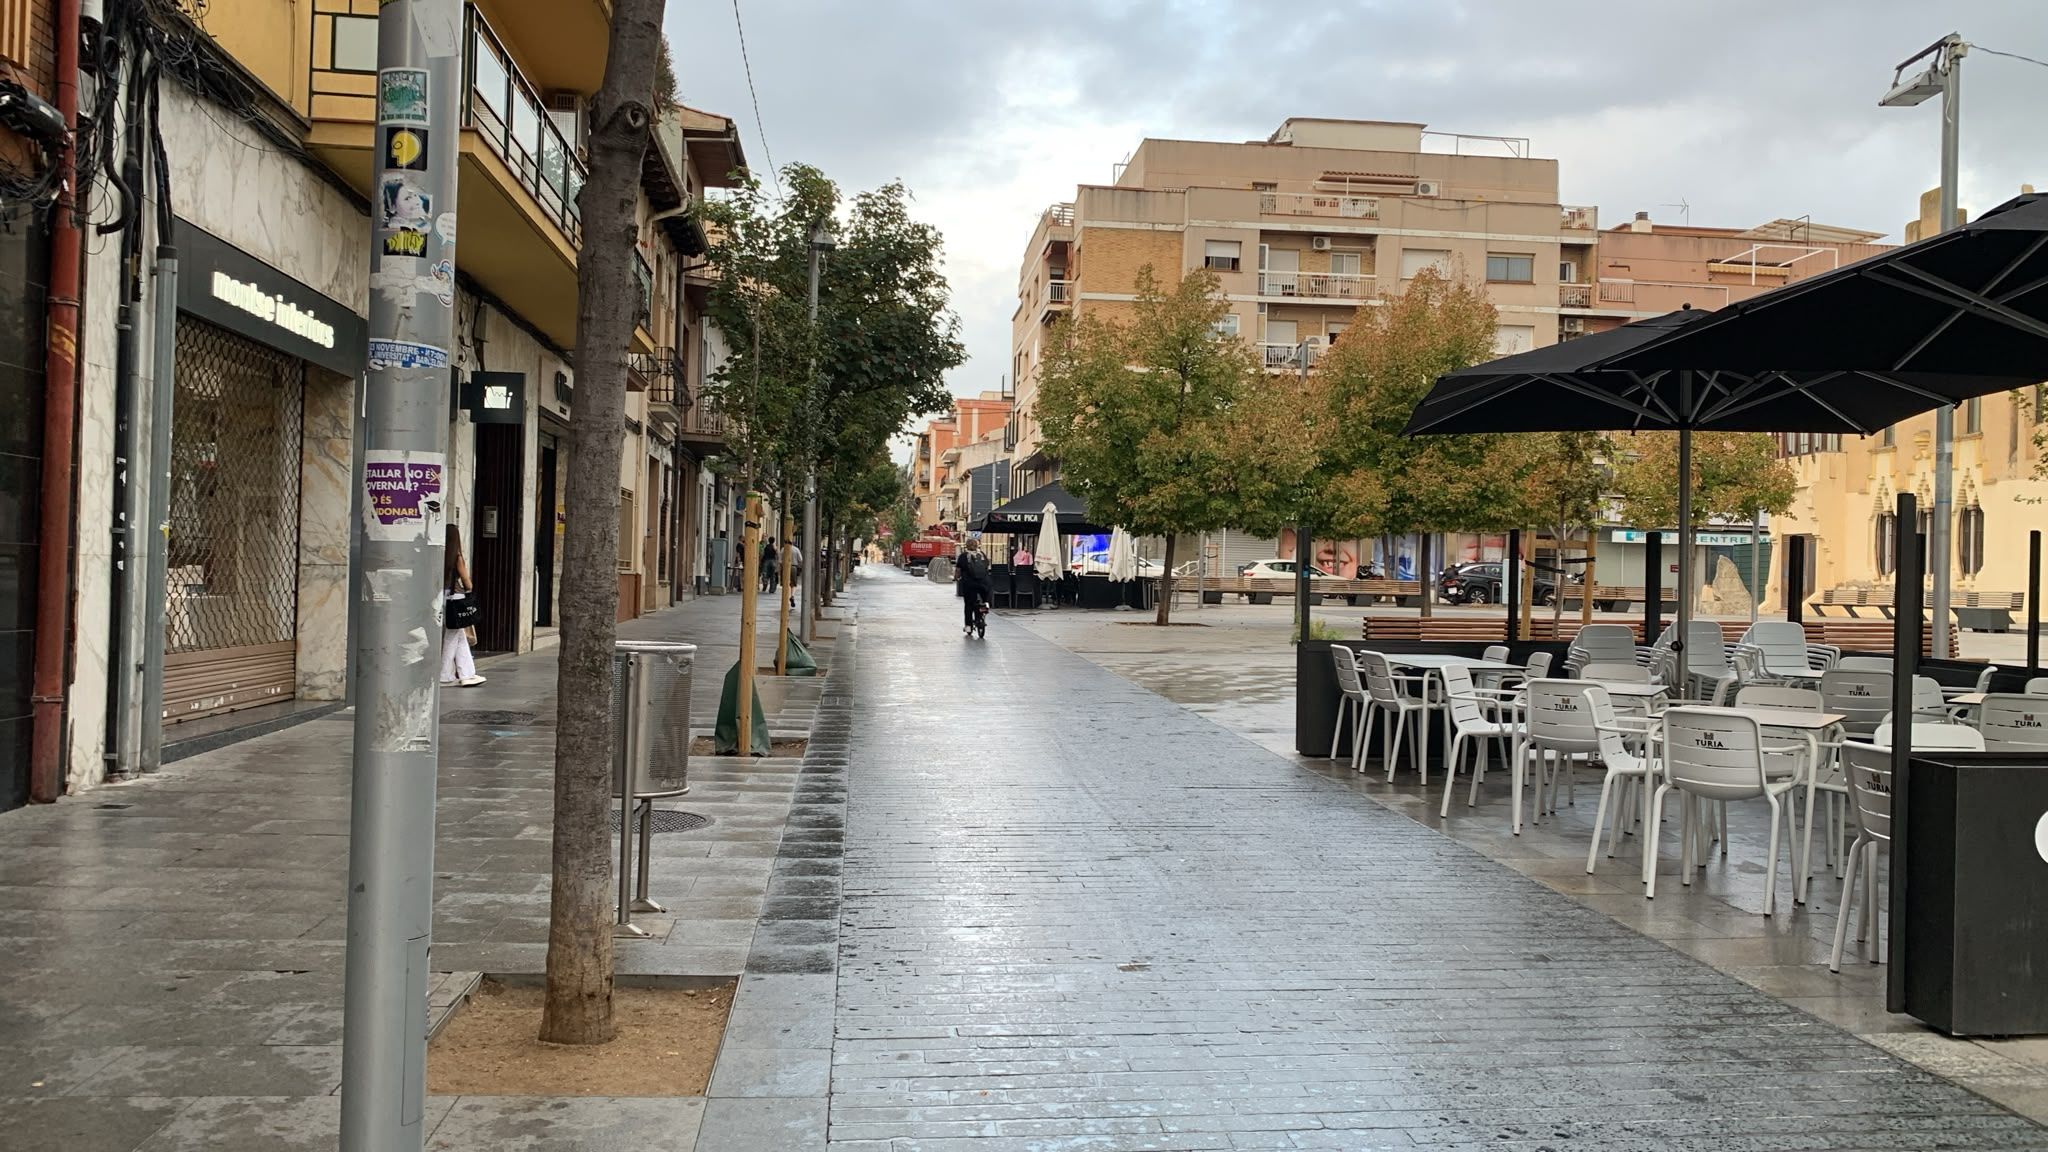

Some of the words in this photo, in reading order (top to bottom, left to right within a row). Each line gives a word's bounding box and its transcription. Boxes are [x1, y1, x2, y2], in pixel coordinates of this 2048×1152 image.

[212, 271, 275, 322] montse
[276, 294, 334, 349] interiors
[376, 343, 419, 355] NOVEMBRE
[366, 469, 401, 478] ETALLAR
[406, 470, 423, 479] NO
[367, 481, 419, 491] OVERNAR?
[380, 494, 392, 505] ÉS
[1007, 514, 1021, 522] PICA
[1024, 514, 1038, 522] PICA
[1554, 703, 1578, 711] TURIA
[2015, 720, 2042, 728] TURIA
[1695, 739, 1724, 748] TURIA
[1866, 780, 1891, 793] TURIA
